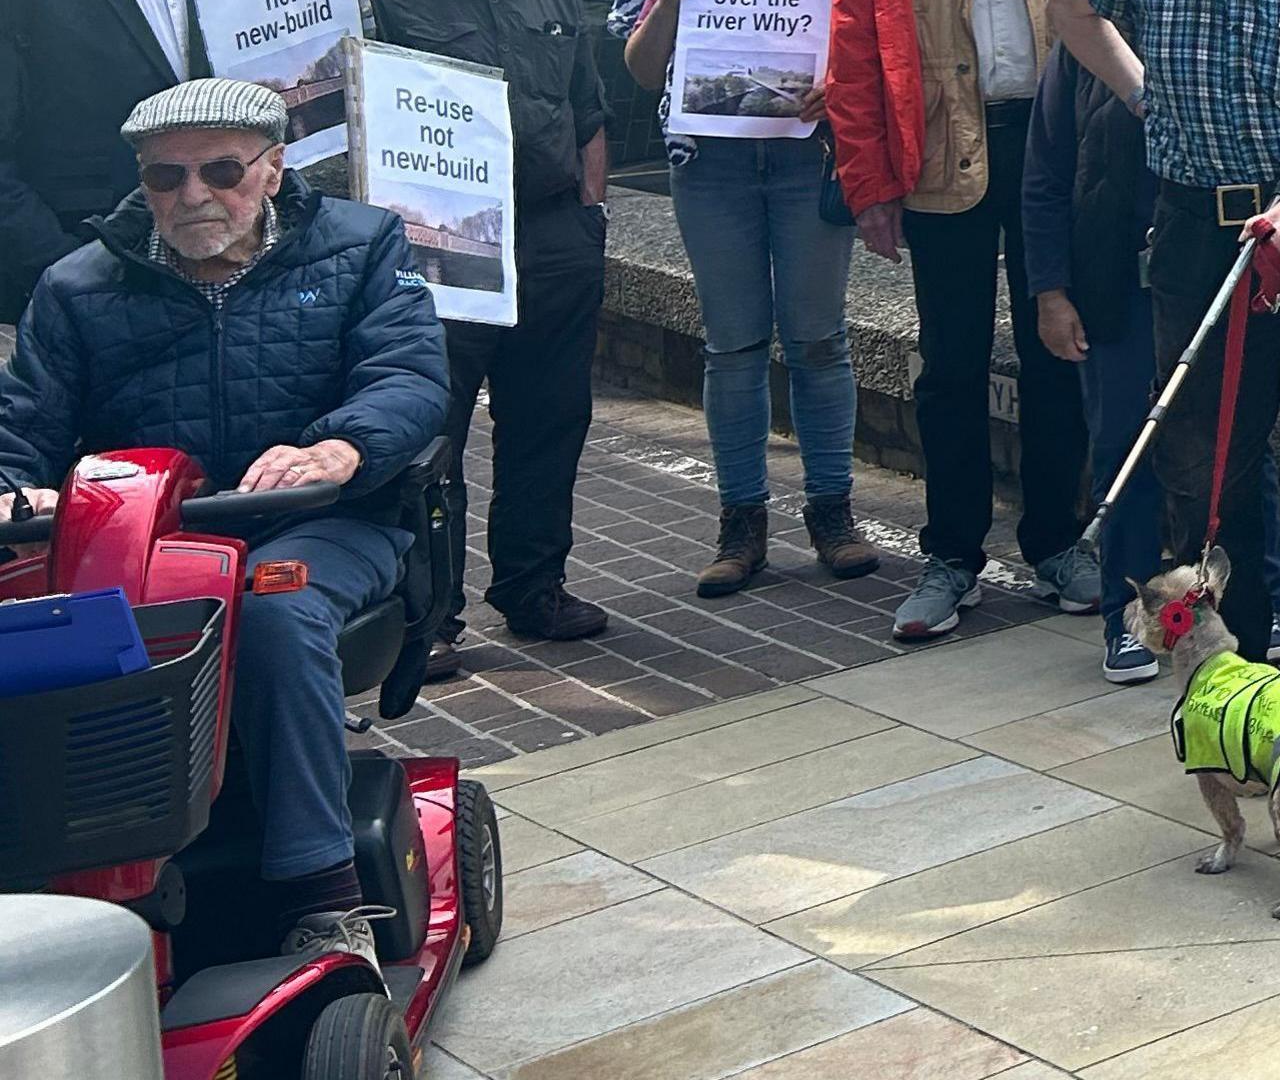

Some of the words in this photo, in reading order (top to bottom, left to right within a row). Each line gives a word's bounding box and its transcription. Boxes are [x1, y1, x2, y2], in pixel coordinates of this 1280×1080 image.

[697, 9, 747, 31] river
[753, 12, 812, 38] Why?
[396, 88, 474, 123] Re-use
[420, 125, 454, 149] not
[381, 148, 489, 185] new-build
